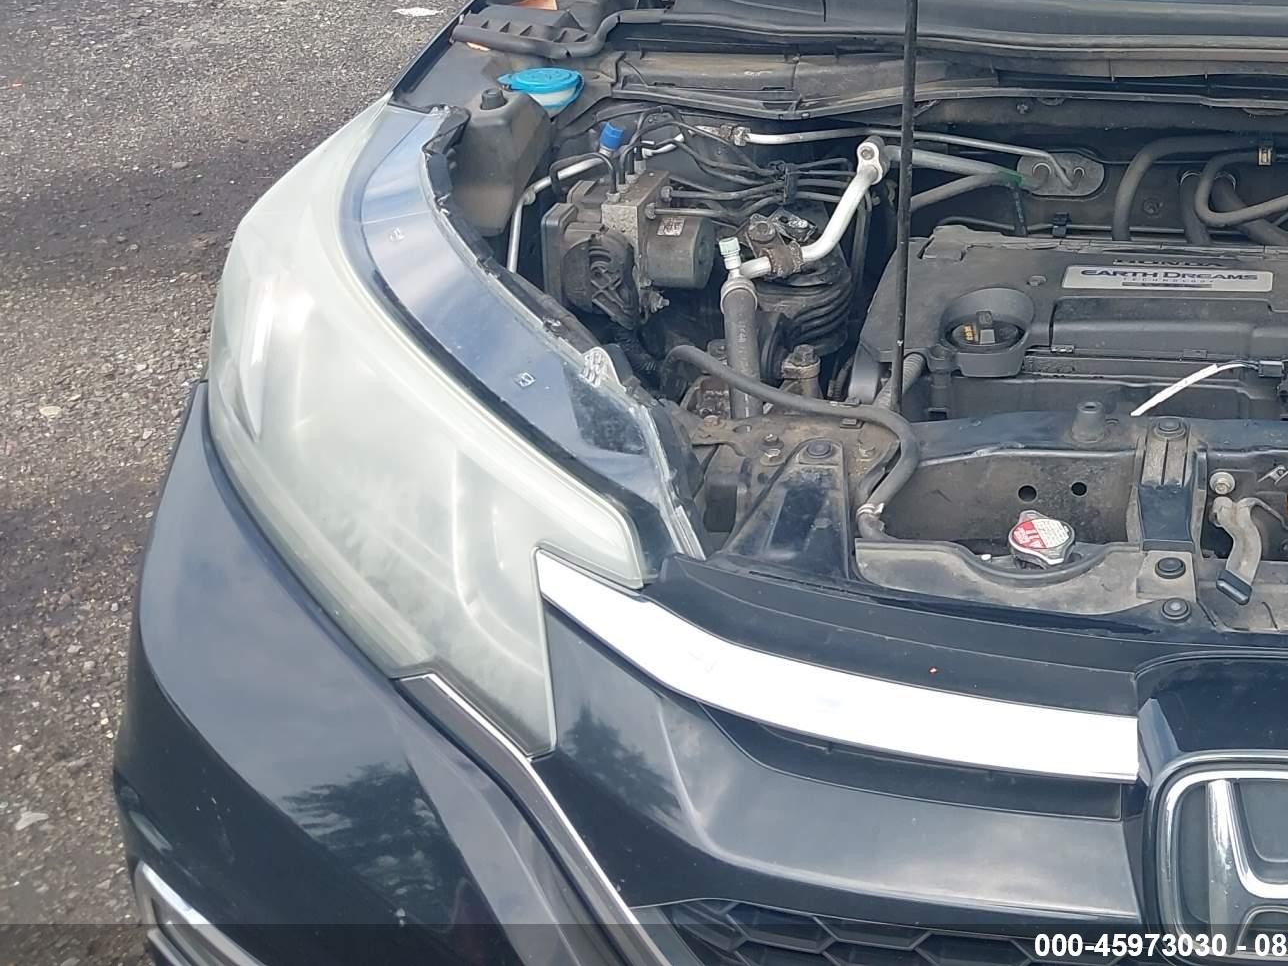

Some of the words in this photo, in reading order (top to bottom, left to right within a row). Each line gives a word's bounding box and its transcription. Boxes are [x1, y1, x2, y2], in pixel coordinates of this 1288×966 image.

[1113, 258, 1224, 267] HONDA
[1080, 269, 1159, 278] EARTH
[1163, 270, 1259, 281] DREAMS
